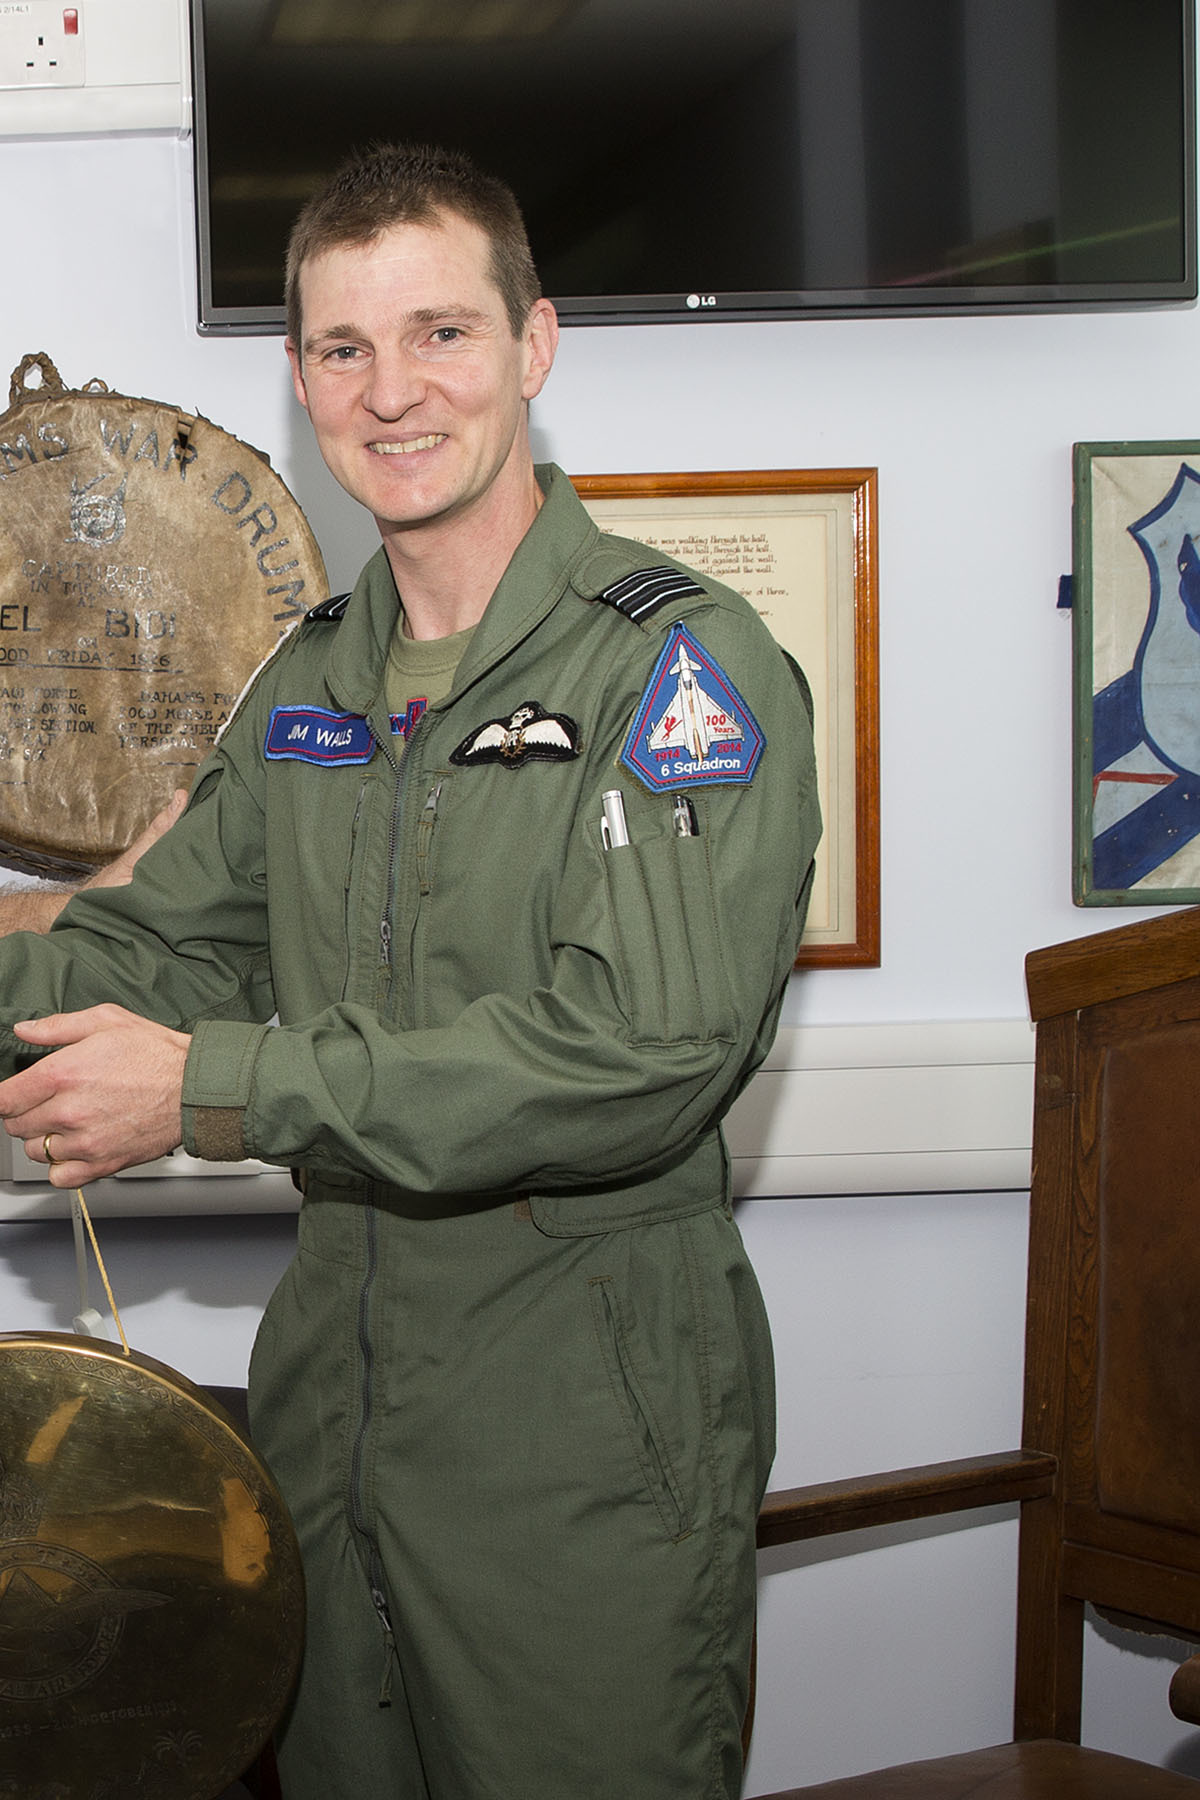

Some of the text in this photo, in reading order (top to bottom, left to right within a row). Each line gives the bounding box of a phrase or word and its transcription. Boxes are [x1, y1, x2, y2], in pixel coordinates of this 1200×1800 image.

[2, 5, 29, 14] 2/14L1
[701, 296, 717, 306] LG
[100, 419, 198, 482] WAR
[661, 538, 676, 546] was
[678, 535, 708, 546] walking
[710, 534, 738, 547] through
[739, 534, 751, 544] the
[683, 545, 694, 555] the
[714, 544, 741, 556] through
[744, 544, 754, 553] the
[742, 555, 754, 564] the
[21, 559, 152, 584] CAPTURED
[743, 565, 754, 574] the
[31, 580, 49, 593] IN
[63, 581, 91, 596] THE
[77, 594, 96, 608] AT
[0, 604, 177, 640] EL BIDI
[47, 649, 115, 664] FRIDAY
[2, 702, 88, 716] FOLLOWING
[706, 714, 727, 727] 100
[145, 723, 173, 735] THE
[119, 735, 198, 749] PERSONAL
[716, 743, 742, 754] 2014
[655, 749, 681, 762] 1914
[661, 757, 741, 777] 6 Squadron
[35, 1676, 73, 1697] AIR
